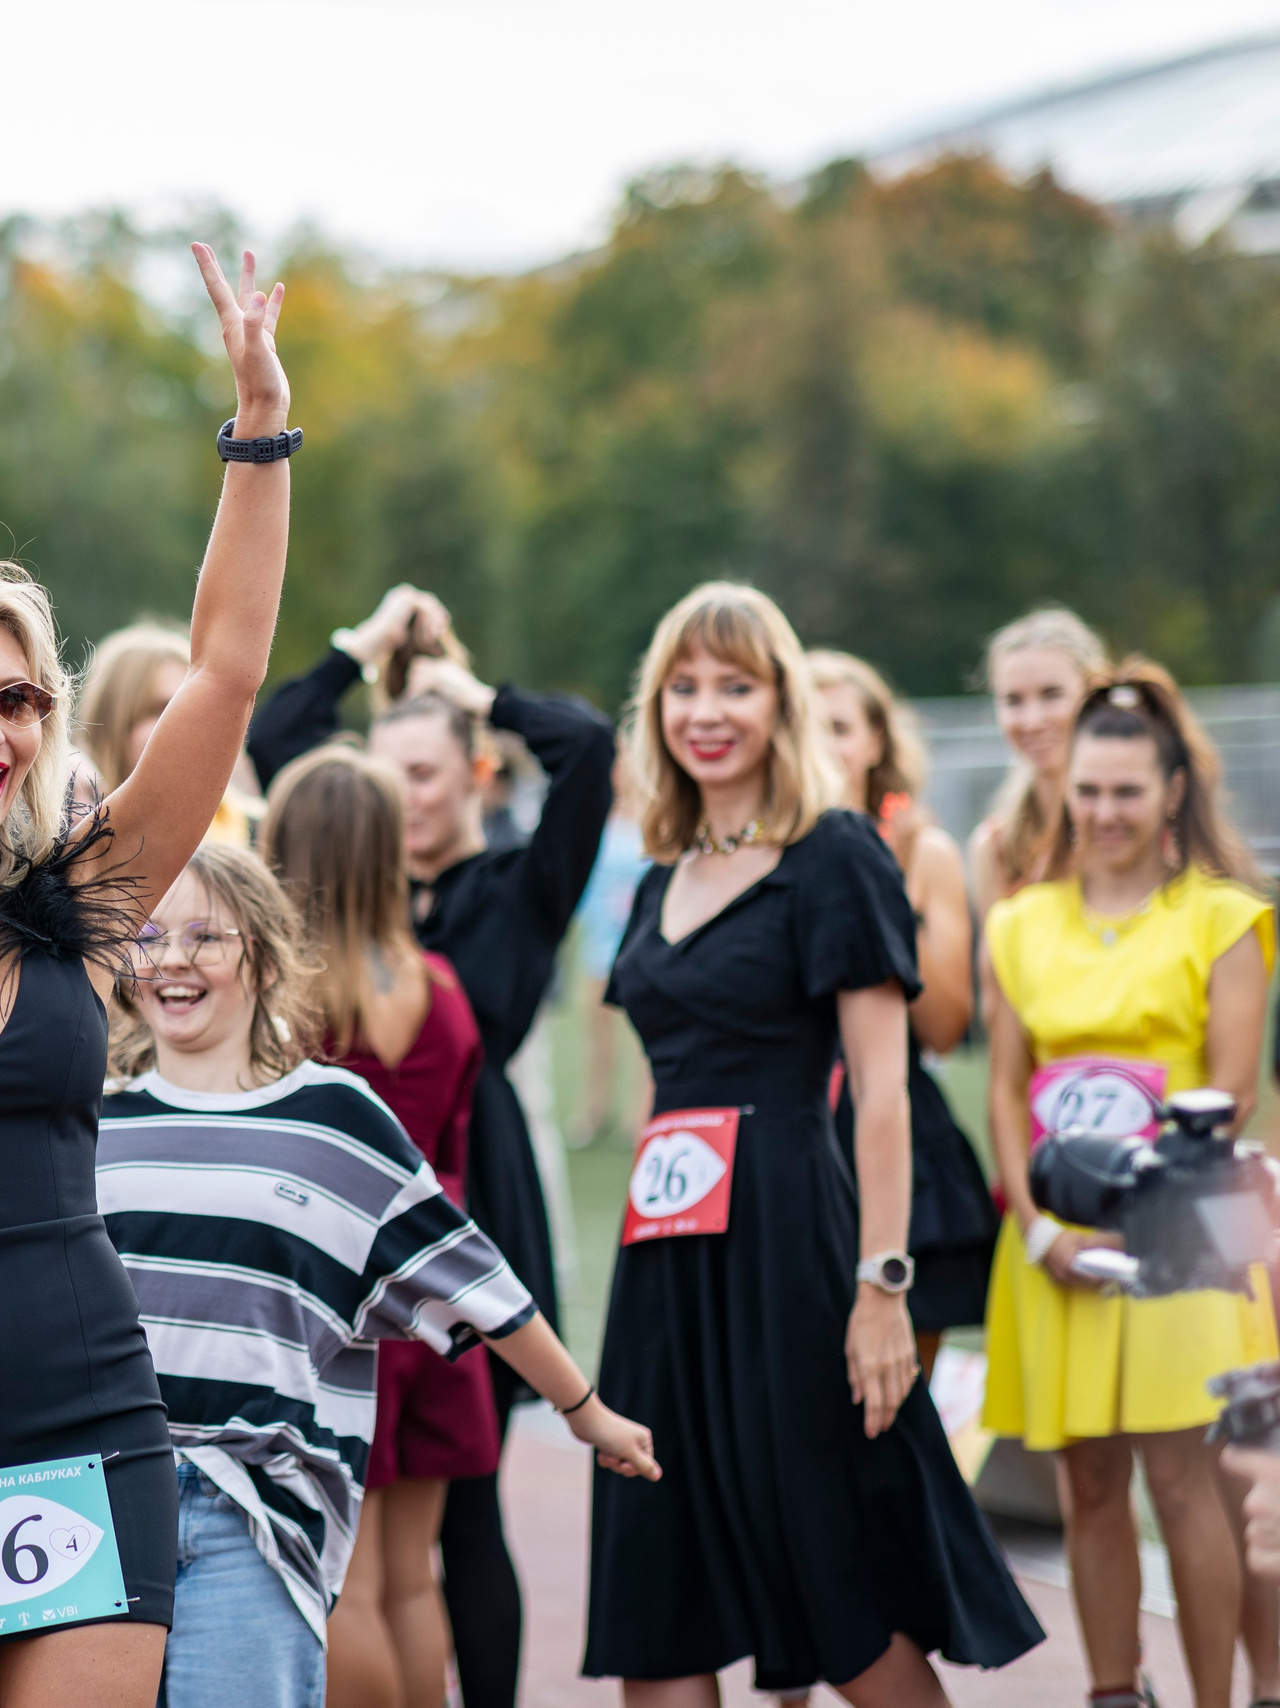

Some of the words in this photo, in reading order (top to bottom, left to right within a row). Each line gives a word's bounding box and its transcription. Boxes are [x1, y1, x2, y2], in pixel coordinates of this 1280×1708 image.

[644, 1147, 691, 1206] 26
[18, 1466, 82, 1486] КАБЛУКАХ
[65, 1534, 78, 1552] 4
[57, 1605, 78, 1618] VBI
